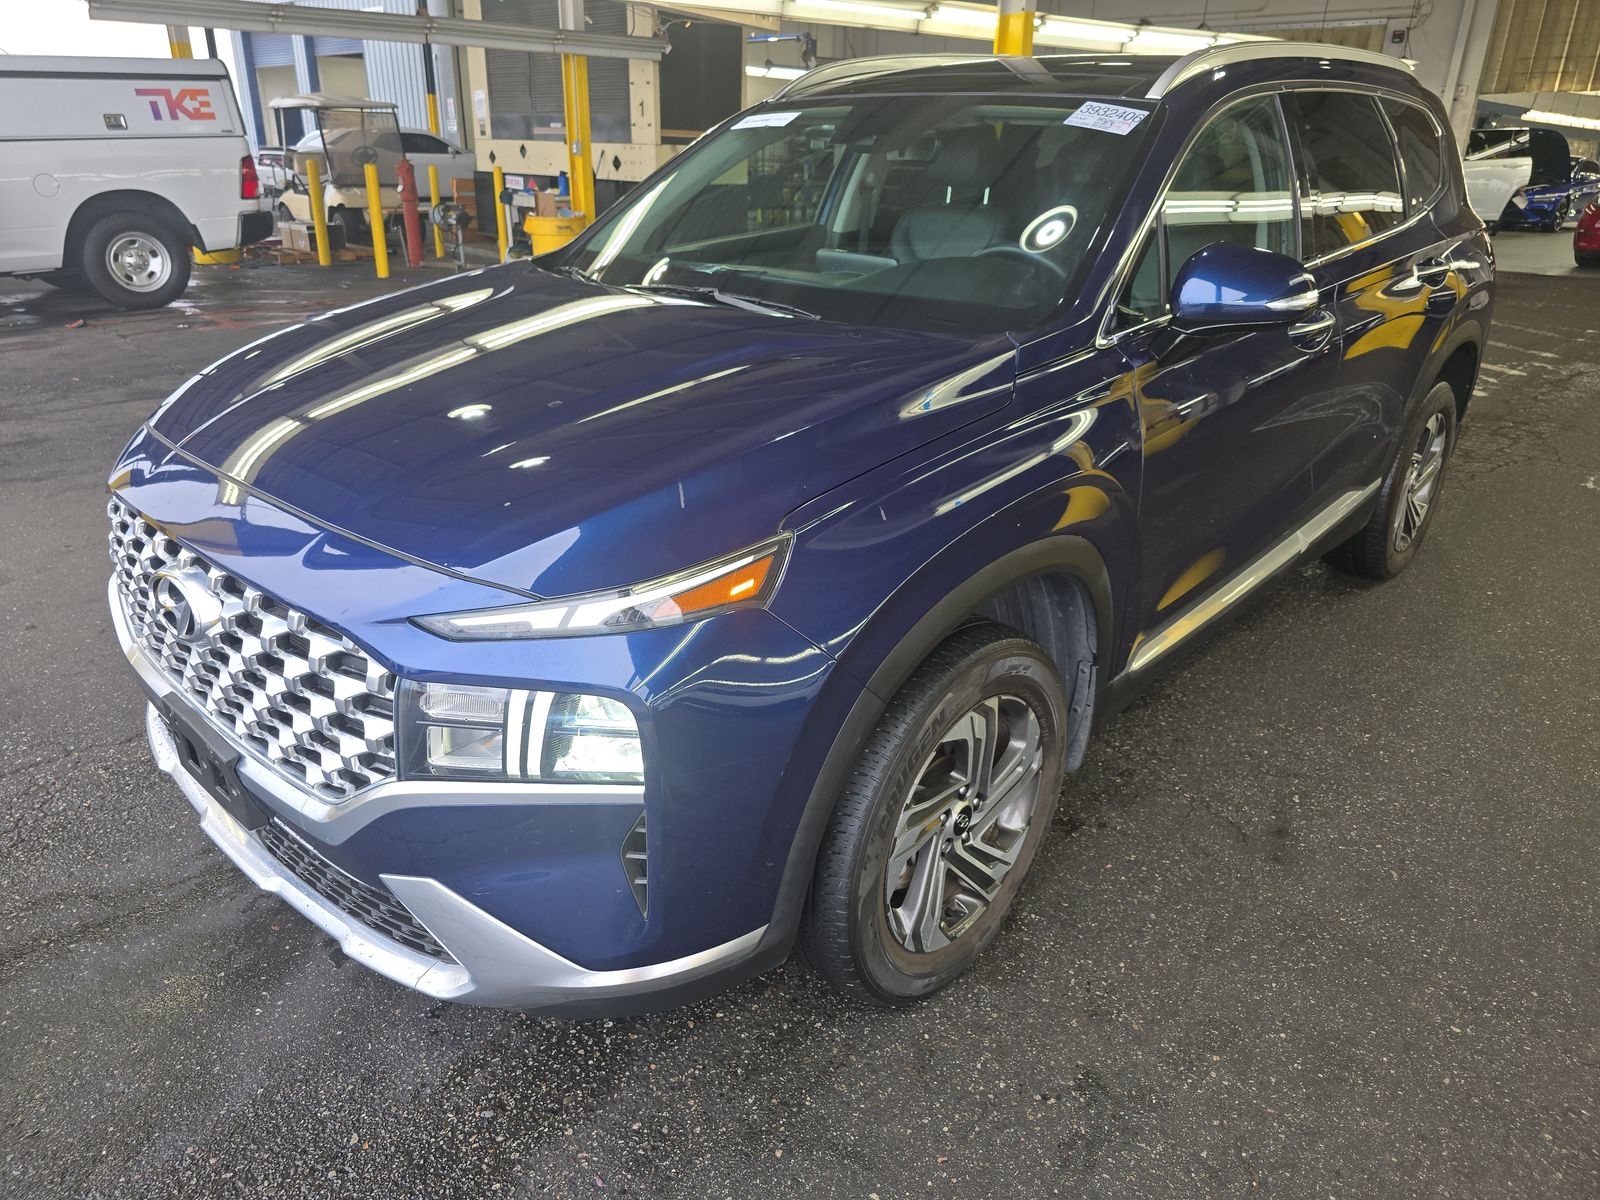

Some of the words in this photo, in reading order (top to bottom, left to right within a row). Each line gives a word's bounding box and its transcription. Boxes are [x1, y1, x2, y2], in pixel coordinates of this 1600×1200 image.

[134, 88, 217, 121] TKE
[638, 100, 645, 117] 1
[1080, 104, 1146, 123] 3932406
